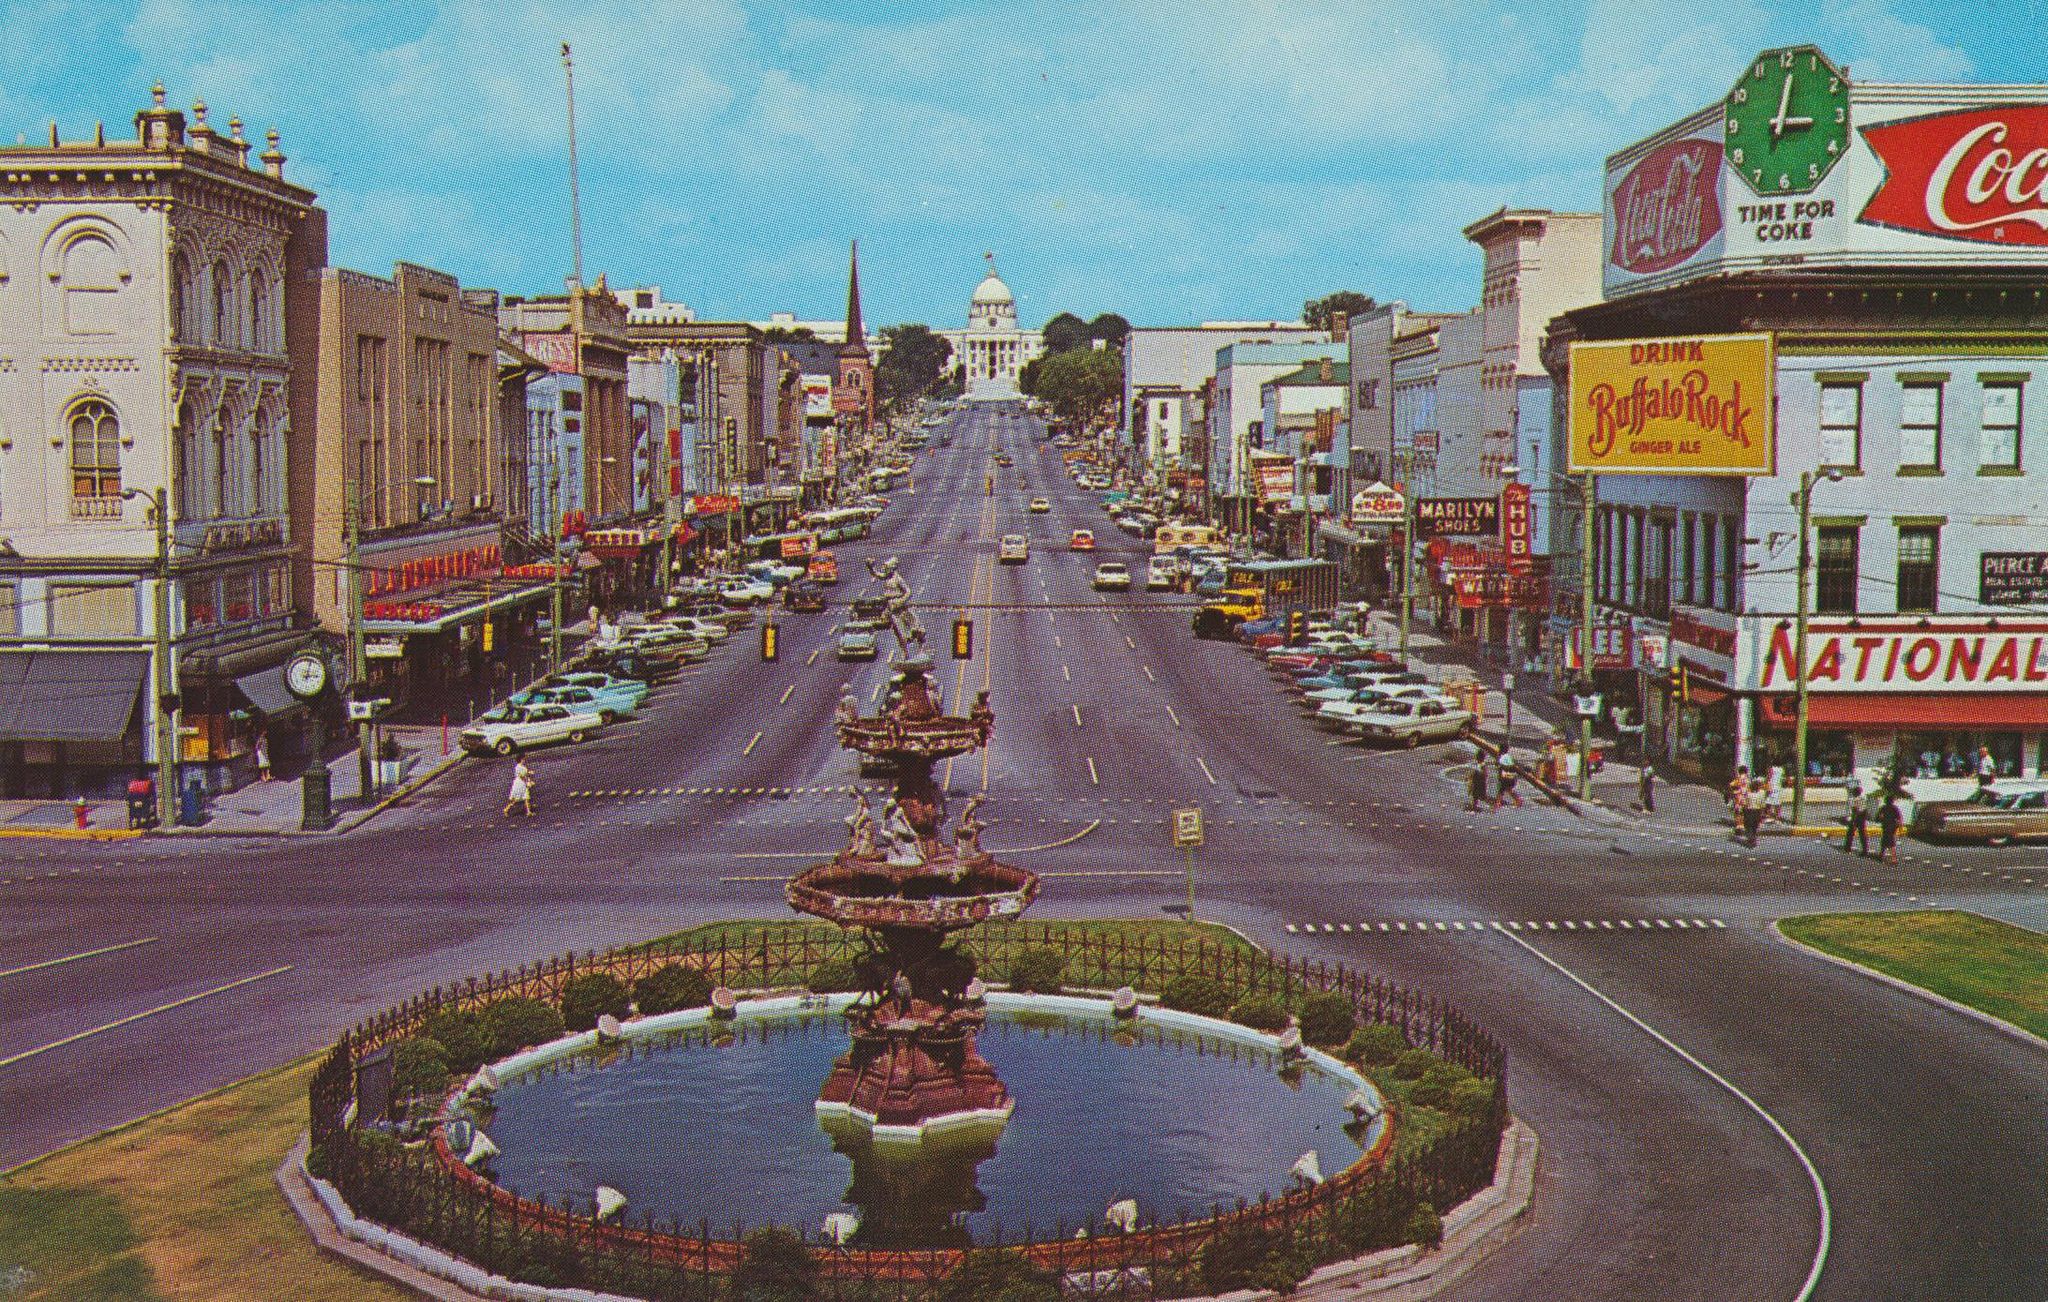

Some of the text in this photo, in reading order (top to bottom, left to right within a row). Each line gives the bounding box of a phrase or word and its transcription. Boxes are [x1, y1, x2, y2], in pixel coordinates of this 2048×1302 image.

[1780, 51, 1794, 68] 12
[1811, 56, 1817, 71] 1
[1754, 61, 1764, 79] 11
[1829, 77, 1839, 93] 2
[1732, 88, 1747, 103] 10
[1836, 107, 1844, 124] 3
[1727, 119, 1738, 134] 9
[1828, 139, 1838, 154] 4
[1733, 148, 1744, 166] 8
[1753, 168, 1762, 184] 7
[1809, 163, 1819, 180] 5
[1925, 121, 2048, 231] Coc
[1779, 173, 1790, 189] 6
[1738, 200, 1834, 223] TIME FOR
[1756, 223, 1813, 242] COKE
[1630, 340, 1704, 365] DRINK
[1588, 368, 1752, 458] Buffalo Rock
[1630, 440, 1701, 454] GINGER ALE
[1420, 502, 1495, 518] MARILYN
[1436, 519, 1480, 531] SHOES
[1510, 504, 1527, 555] HUB
[1983, 557, 2036, 574] PIERCE
[1761, 622, 2048, 688] NATIONAL
